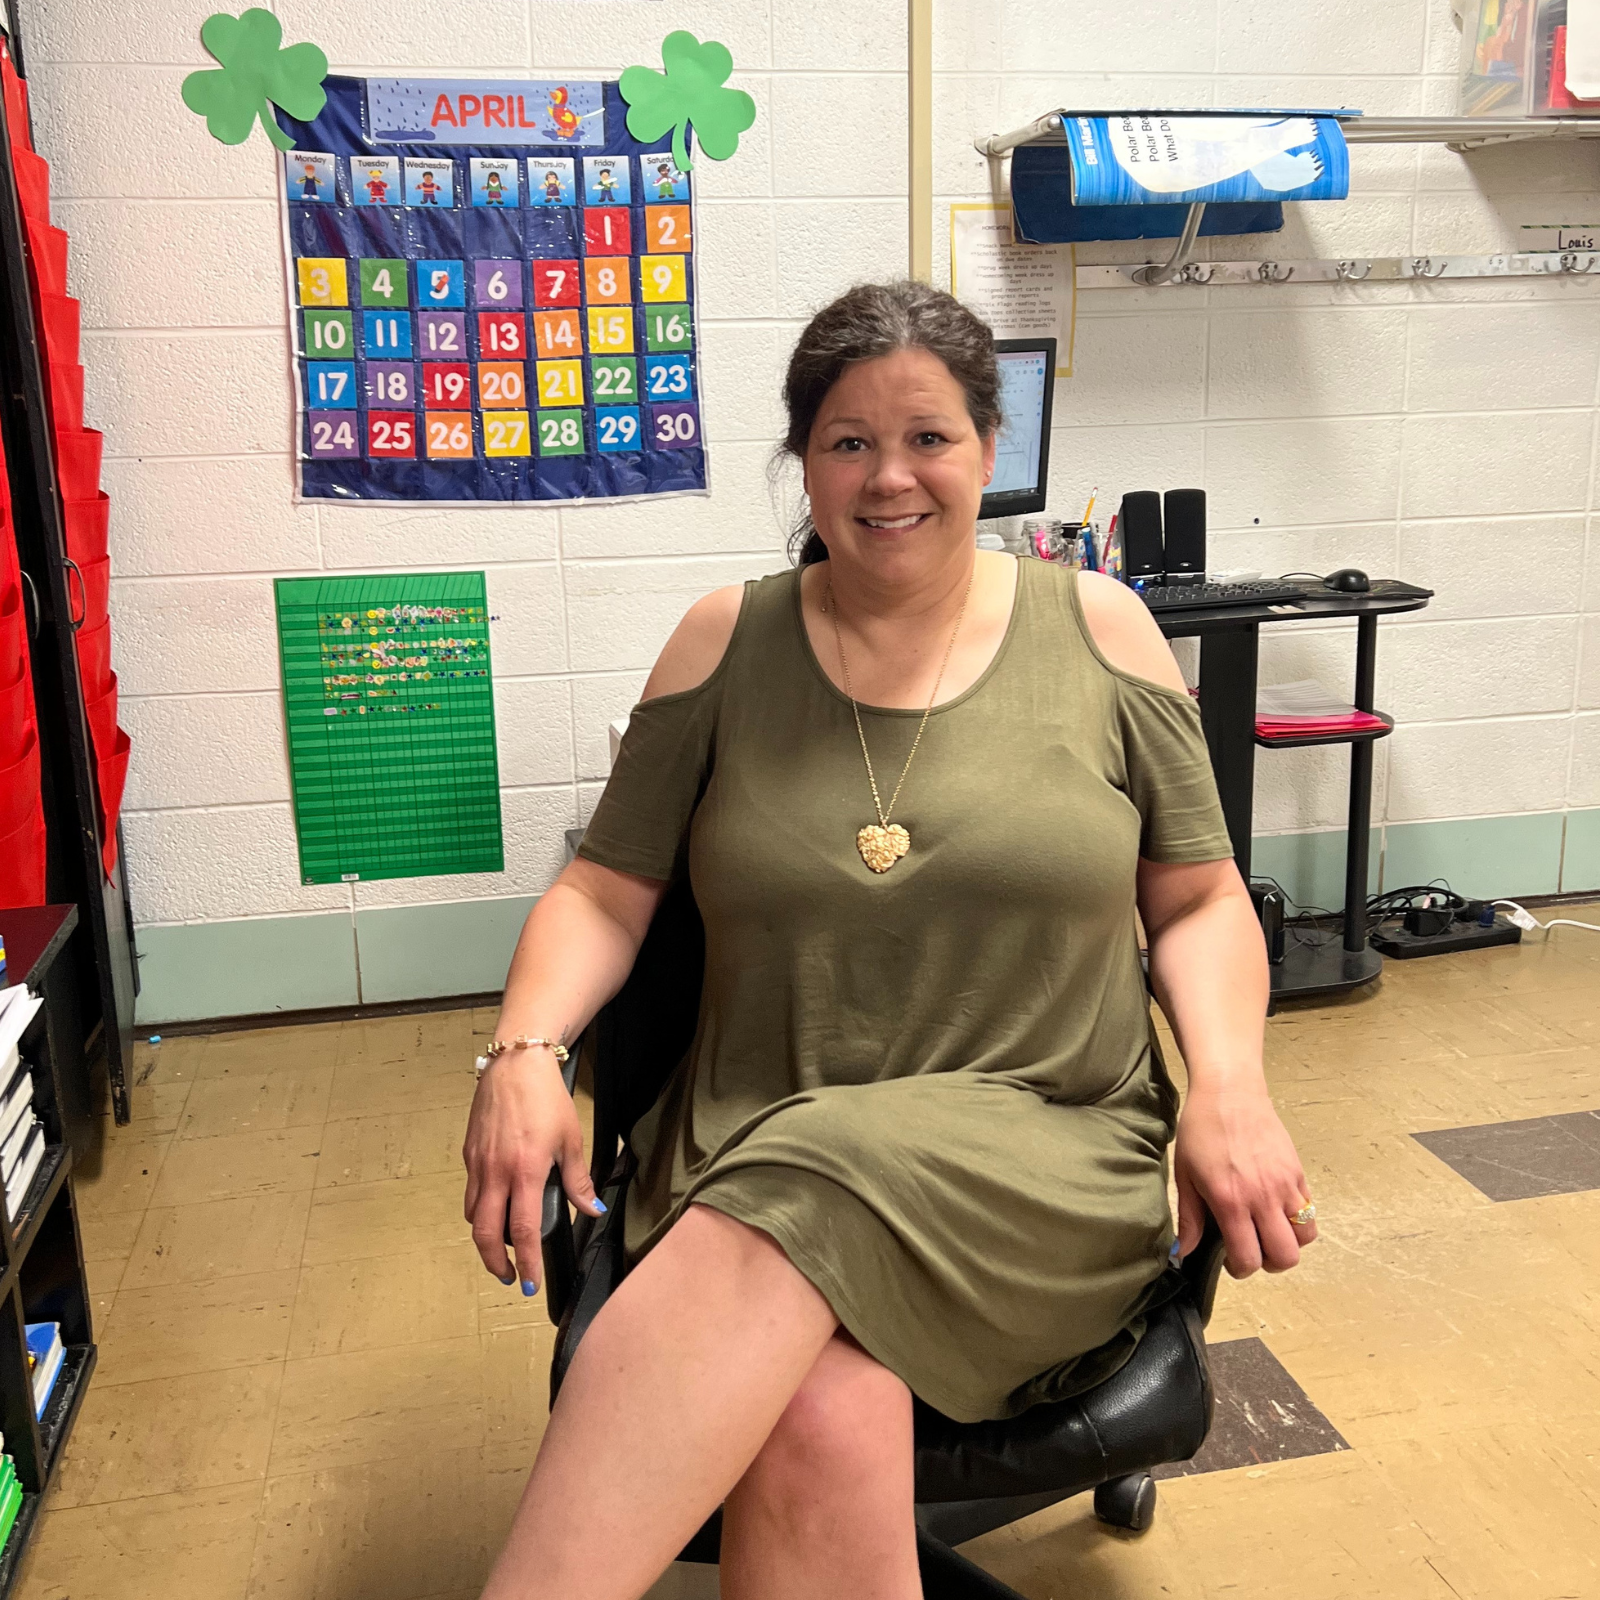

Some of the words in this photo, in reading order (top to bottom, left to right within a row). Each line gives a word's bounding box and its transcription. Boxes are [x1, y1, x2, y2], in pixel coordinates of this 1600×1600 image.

[430, 93, 536, 128] APRIL
[1121, 116, 1134, 132] Bea
[1140, 116, 1153, 132] Bea
[1160, 119, 1171, 132] Do
[1083, 148, 1098, 165] Bill
[1127, 134, 1141, 163] Polar
[1146, 134, 1160, 162] Polar
[1163, 134, 1179, 162] What
[294, 154, 327, 164] Monday
[357, 159, 390, 169] Tuesday
[405, 160, 450, 170] Wednesday
[480, 160, 508, 171] Sunday
[593, 159, 616, 168] Friday
[646, 155, 674, 165] Saturda
[604, 215, 613, 245] 1
[658, 216, 677, 245] 2
[1558, 230, 1594, 250] Louis
[310, 267, 330, 297] 3
[372, 268, 394, 298] 4
[429, 270, 450, 299] 5
[487, 270, 508, 300] 6
[545, 270, 566, 299] 7
[598, 267, 617, 297] 8
[652, 265, 672, 294] 9
[314, 320, 346, 349] 10
[375, 318, 398, 348] 11
[428, 322, 459, 351] 12
[489, 322, 520, 351] 13
[544, 320, 576, 349] 14
[597, 316, 626, 345] 15
[655, 314, 685, 343] 16
[318, 372, 348, 401] 17
[377, 372, 408, 401] 18
[434, 373, 464, 401] 19
[482, 371, 522, 400] 20
[543, 369, 576, 398] 21
[594, 366, 633, 395] 22
[650, 364, 688, 393] 23
[313, 421, 355, 450] 24
[372, 420, 412, 450] 25
[429, 421, 469, 450] 26
[487, 421, 525, 449] 27
[541, 418, 580, 447] 28
[600, 415, 637, 444] 29
[656, 412, 695, 442] 30
